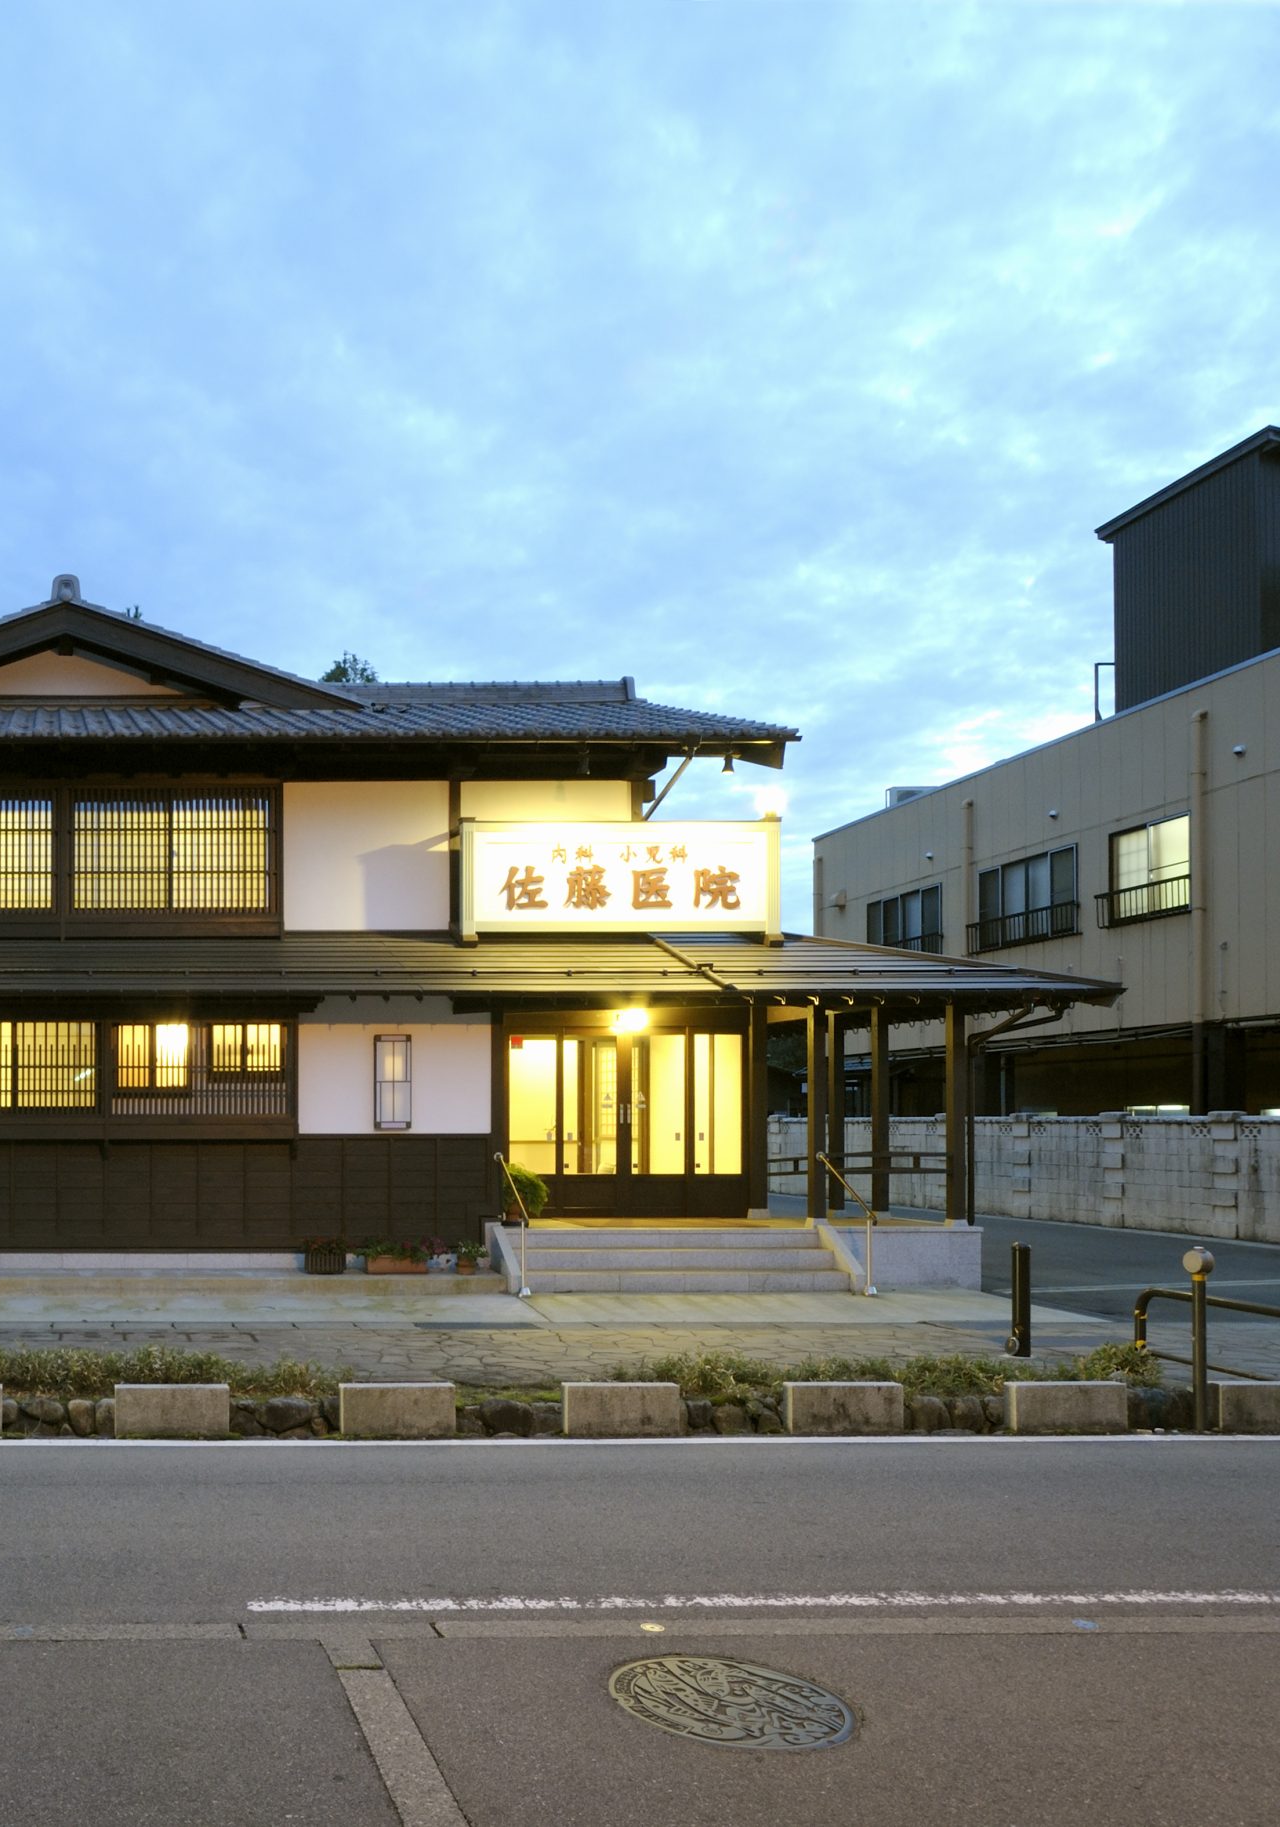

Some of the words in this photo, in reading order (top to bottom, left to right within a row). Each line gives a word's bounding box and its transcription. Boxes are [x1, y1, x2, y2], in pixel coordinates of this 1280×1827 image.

[551, 844, 593, 864] 内科
[619, 845, 688, 864] 小児科
[498, 864, 741, 910] 佐藤医院
